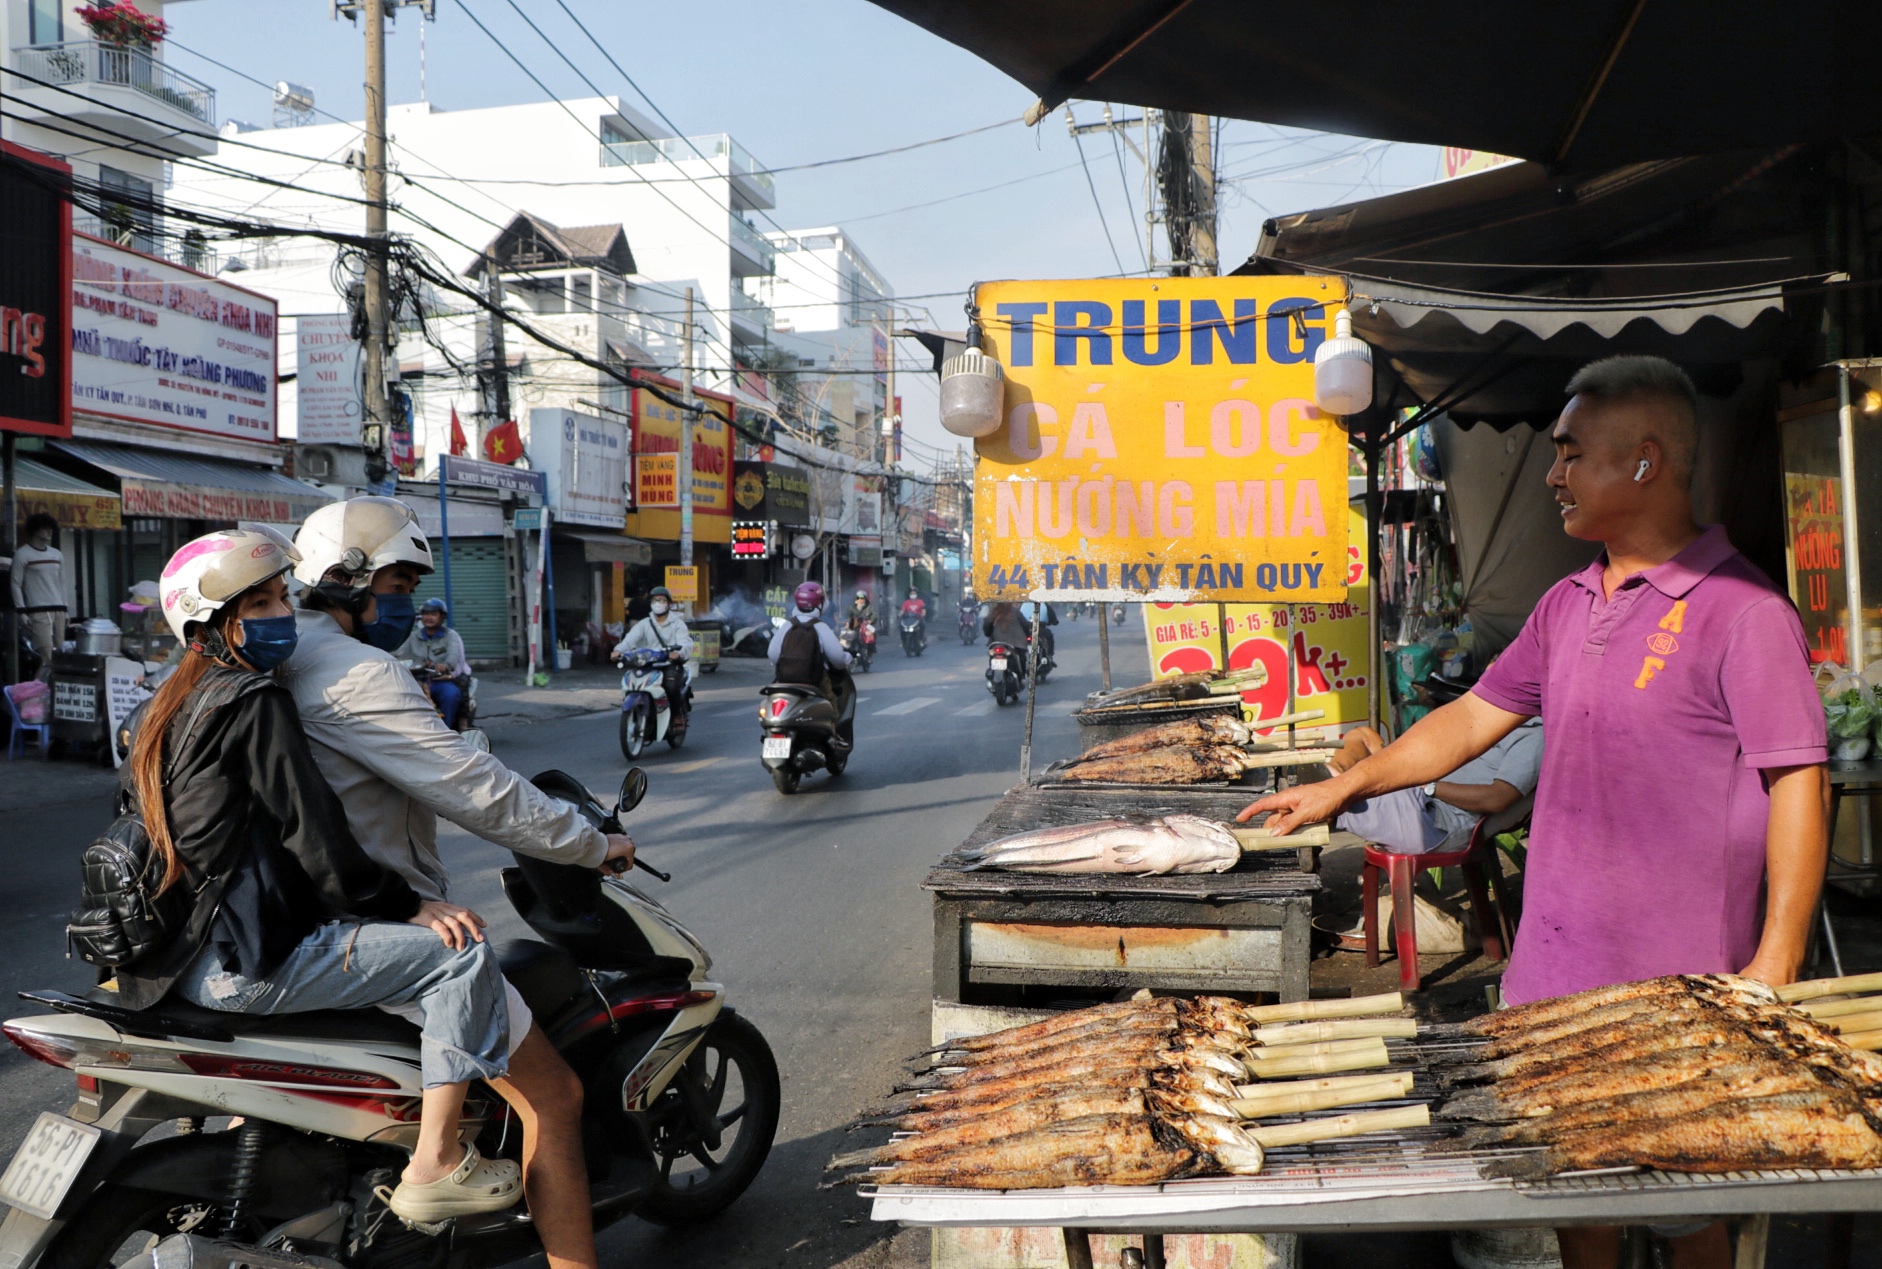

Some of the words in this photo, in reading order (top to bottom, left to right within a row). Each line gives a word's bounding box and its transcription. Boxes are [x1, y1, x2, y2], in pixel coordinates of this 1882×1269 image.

[220, 300, 252, 333] KHOA
[254, 309, 273, 339] NHI
[997, 297, 1326, 367] TRUNG
[301, 331, 352, 345] CHUYÊN
[154, 346, 178, 373] TÂY
[309, 352, 344, 364] KHOA
[316, 371, 338, 381] NHI
[1009, 382, 1116, 458] CÁ
[1165, 379, 1319, 458] LÓC
[458, 471, 479, 482] KHU
[480, 473, 498, 486] PHỐ
[500, 478, 517, 489] VĂN
[518, 481, 536, 493] HÓA
[642, 474, 672, 486] MINH
[124, 483, 165, 513] PHÒNG
[167, 486, 200, 515] KHÁM
[203, 491, 243, 518] CHUYÊN
[246, 498, 271, 520] KHOA
[273, 501, 290, 521] NHI
[641, 487, 673, 502] HÙNG
[995, 463, 1194, 538] NƯỚNG
[1216, 463, 1327, 538] MÍA
[669, 568, 694, 576] TRUNG
[989, 564, 1030, 589] 44
[1041, 556, 1107, 589] TÂN
[1121, 552, 1165, 589] KỲ
[1176, 554, 1243, 589] TÂN
[1256, 550, 1324, 592] QUÝ
[765, 585, 788, 603] CẮT
[765, 604, 786, 618] TÓC
[1658, 599, 1688, 634] A
[1156, 622, 1177, 643] GIÁ
[1180, 618, 1199, 640] RẺ:
[1201, 620, 1210, 638] 5
[1226, 616, 1235, 635] 0
[1246, 613, 1261, 631] 15
[1272, 610, 1288, 629] 20
[1300, 607, 1316, 625] 35
[1634, 656, 1665, 689] F
[237, 1062, 284, 1073] AIR
[7, 1159, 63, 1207] 1616
